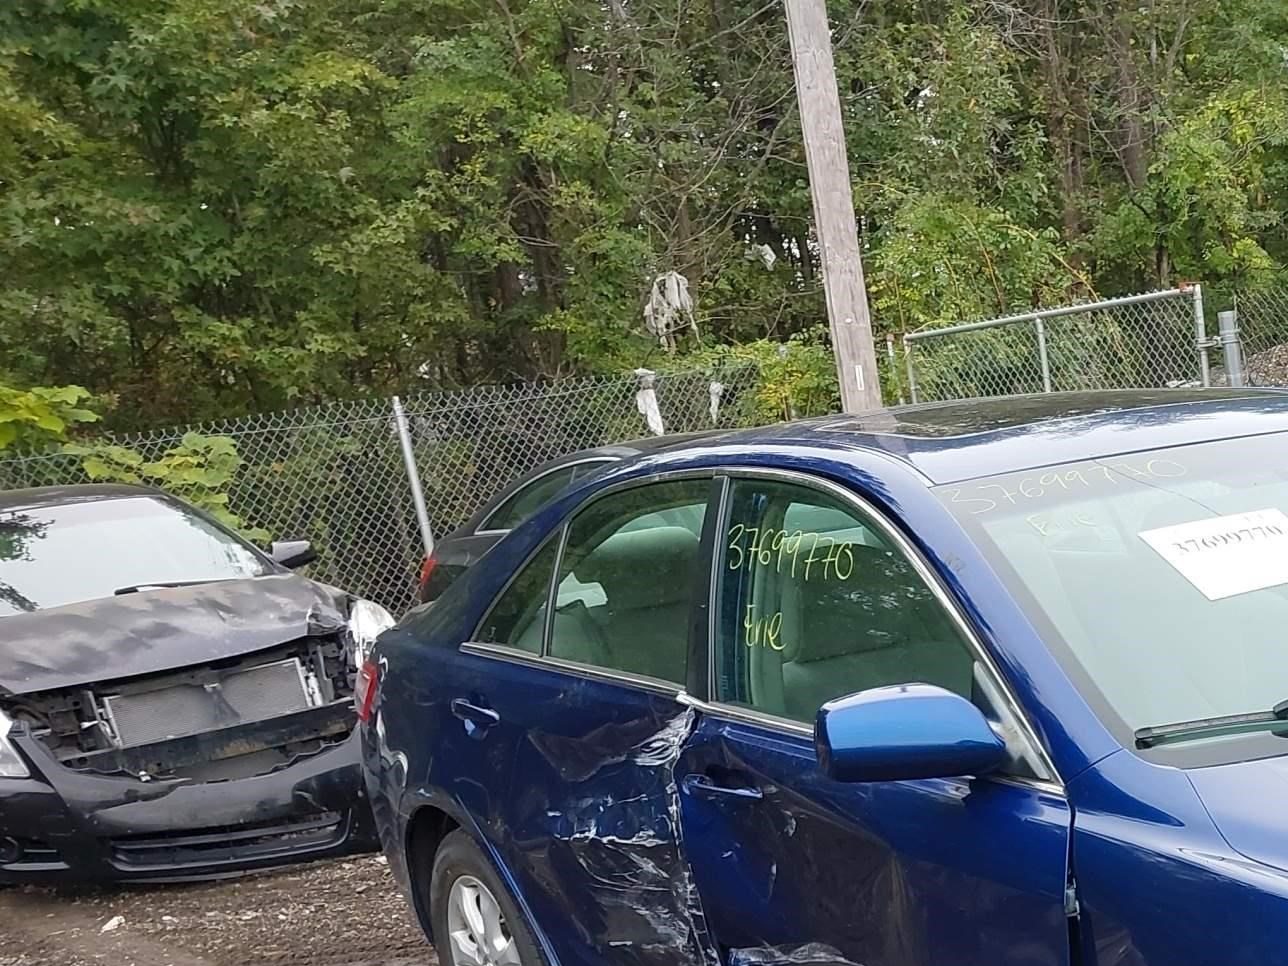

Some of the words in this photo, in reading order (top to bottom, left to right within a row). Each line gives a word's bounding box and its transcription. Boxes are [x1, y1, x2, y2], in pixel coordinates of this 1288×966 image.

[942, 459, 1187, 515] 37699770
[727, 523, 855, 581] 37699770
[1172, 524, 1284, 555] 37699770
